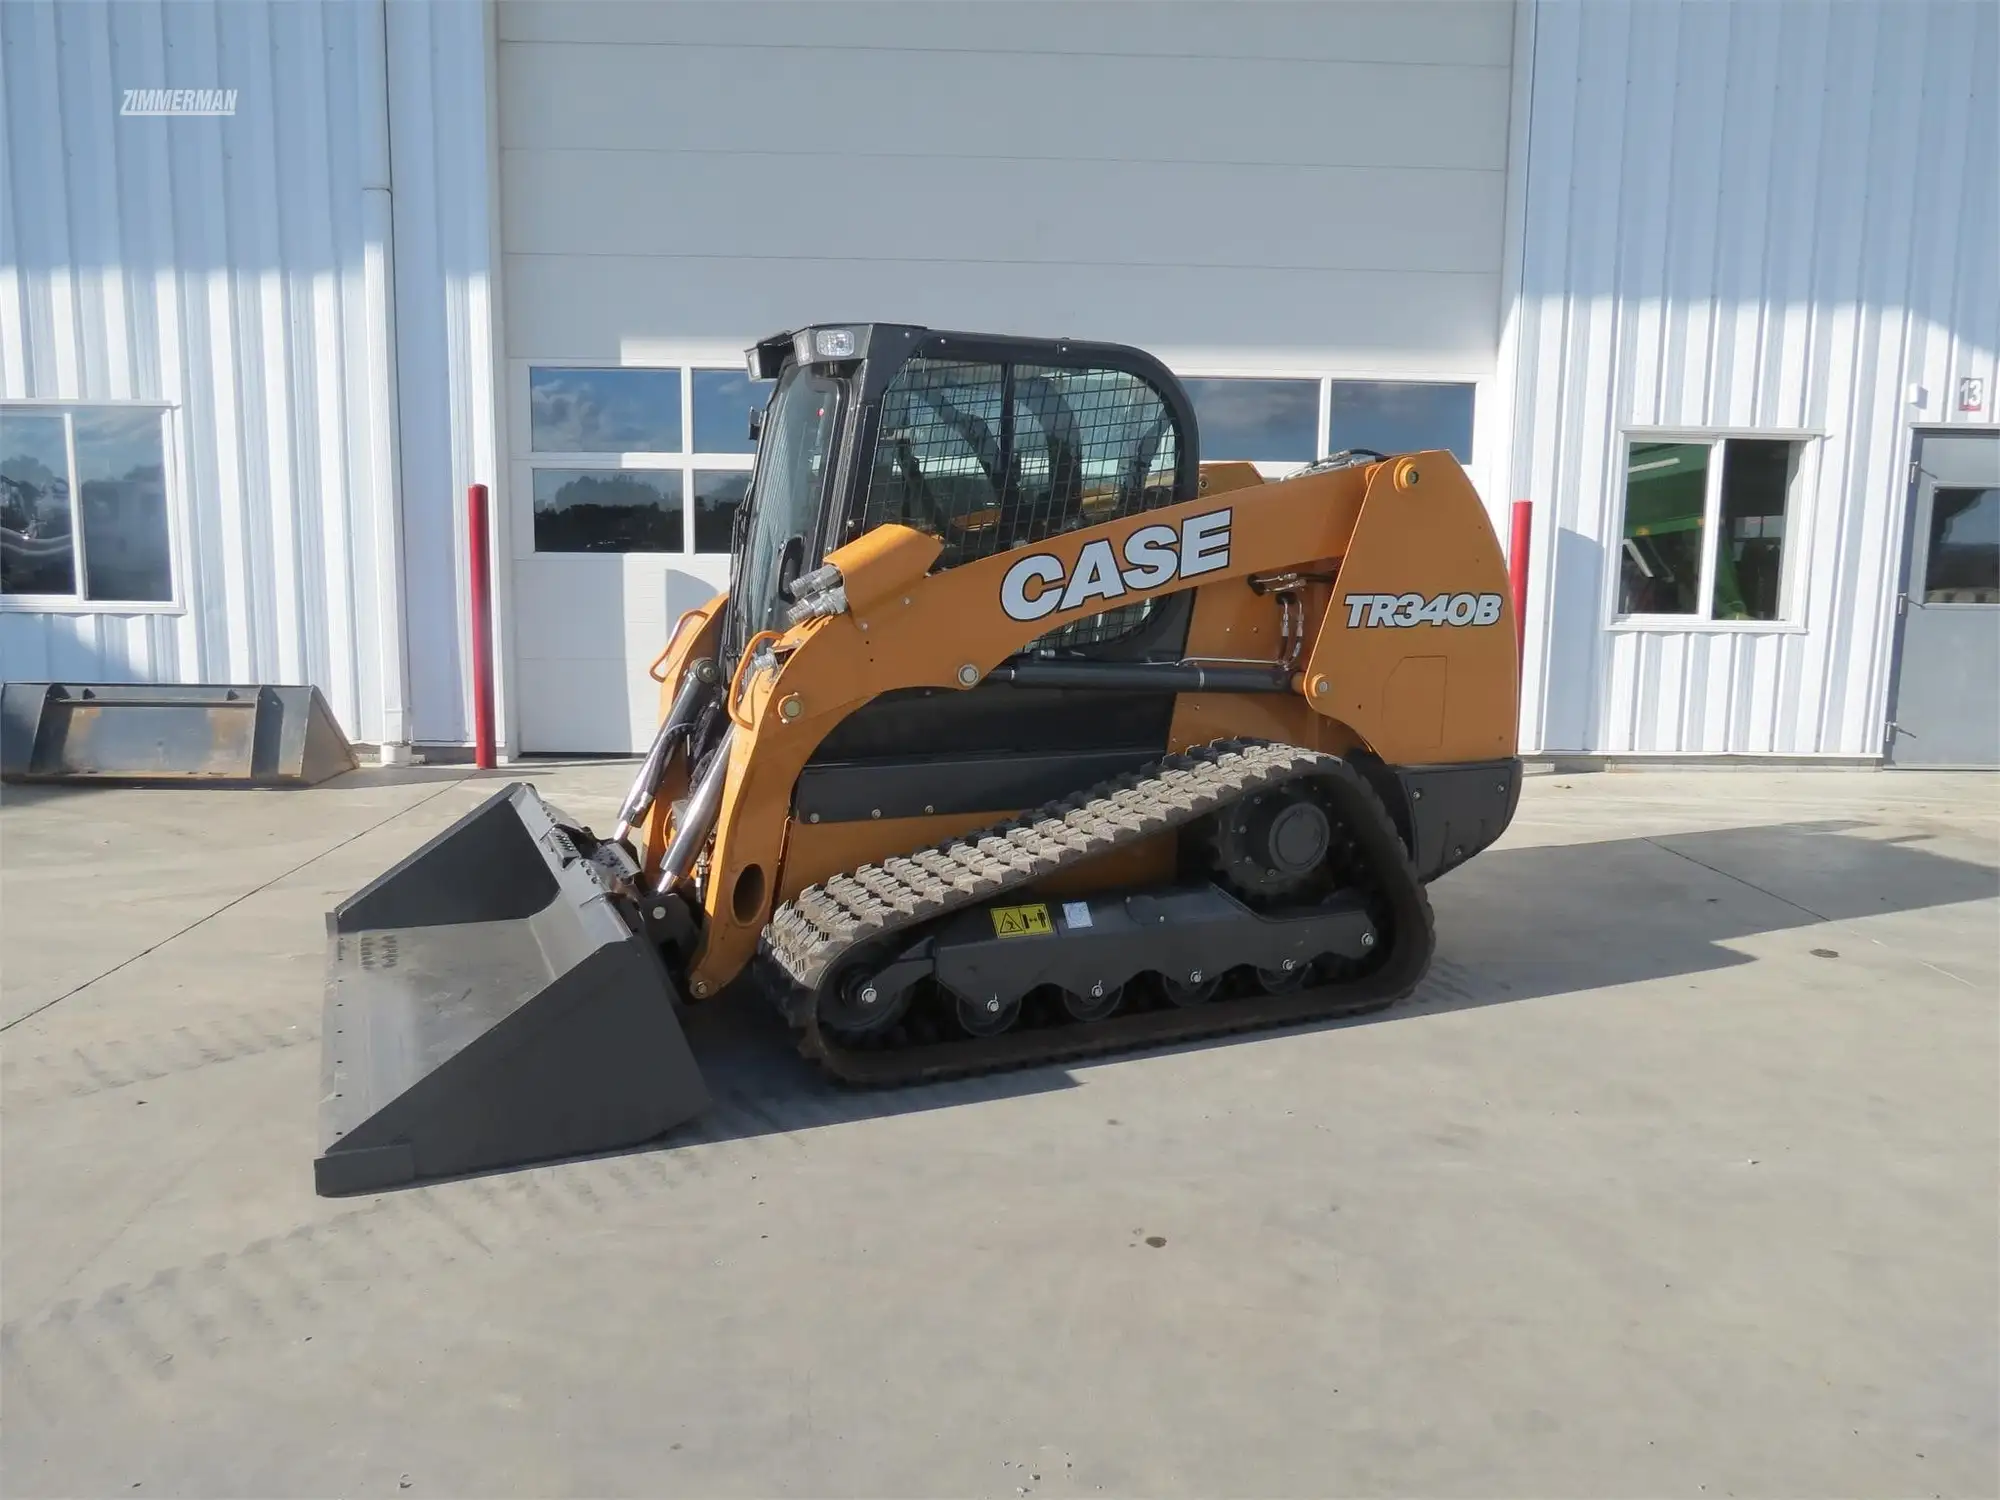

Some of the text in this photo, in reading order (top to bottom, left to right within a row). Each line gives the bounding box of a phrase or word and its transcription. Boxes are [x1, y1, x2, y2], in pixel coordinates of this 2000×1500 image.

[1960, 379, 1982, 407] 13
[1000, 507, 1232, 622] CASE
[1344, 592, 1504, 628] TR340B
